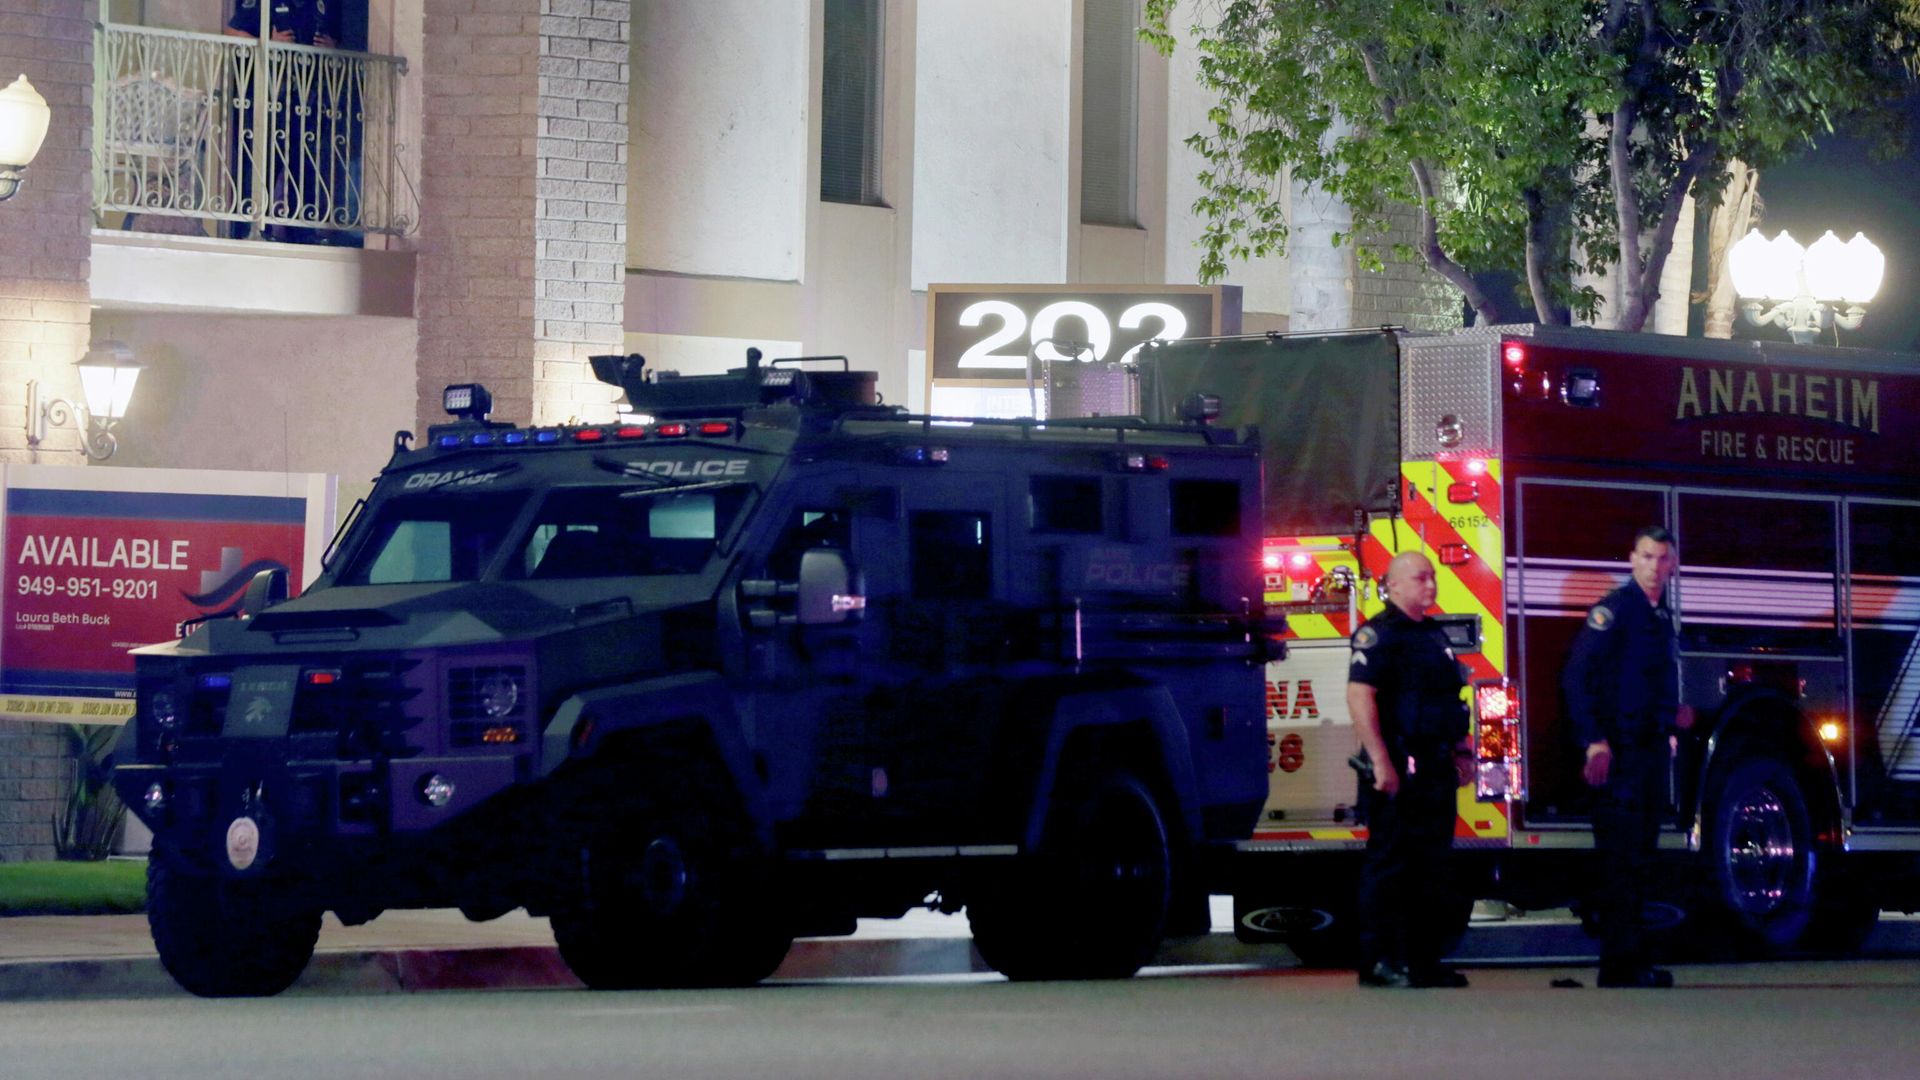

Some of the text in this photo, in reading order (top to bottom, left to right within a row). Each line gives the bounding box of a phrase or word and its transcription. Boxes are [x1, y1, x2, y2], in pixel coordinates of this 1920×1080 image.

[957, 300, 1187, 368] 202
[1675, 367, 1880, 434] ANAHEIM
[1700, 430, 1855, 465] FIRE & RESCUE
[623, 459, 750, 477] POLICE
[1449, 515, 1488, 529] 66152
[18, 535, 190, 570] AVAILABLE
[1084, 562, 1191, 586] POLICE
[17, 575, 158, 599] 949-951-9201
[16, 611, 110, 625] Laura Beth Buck
